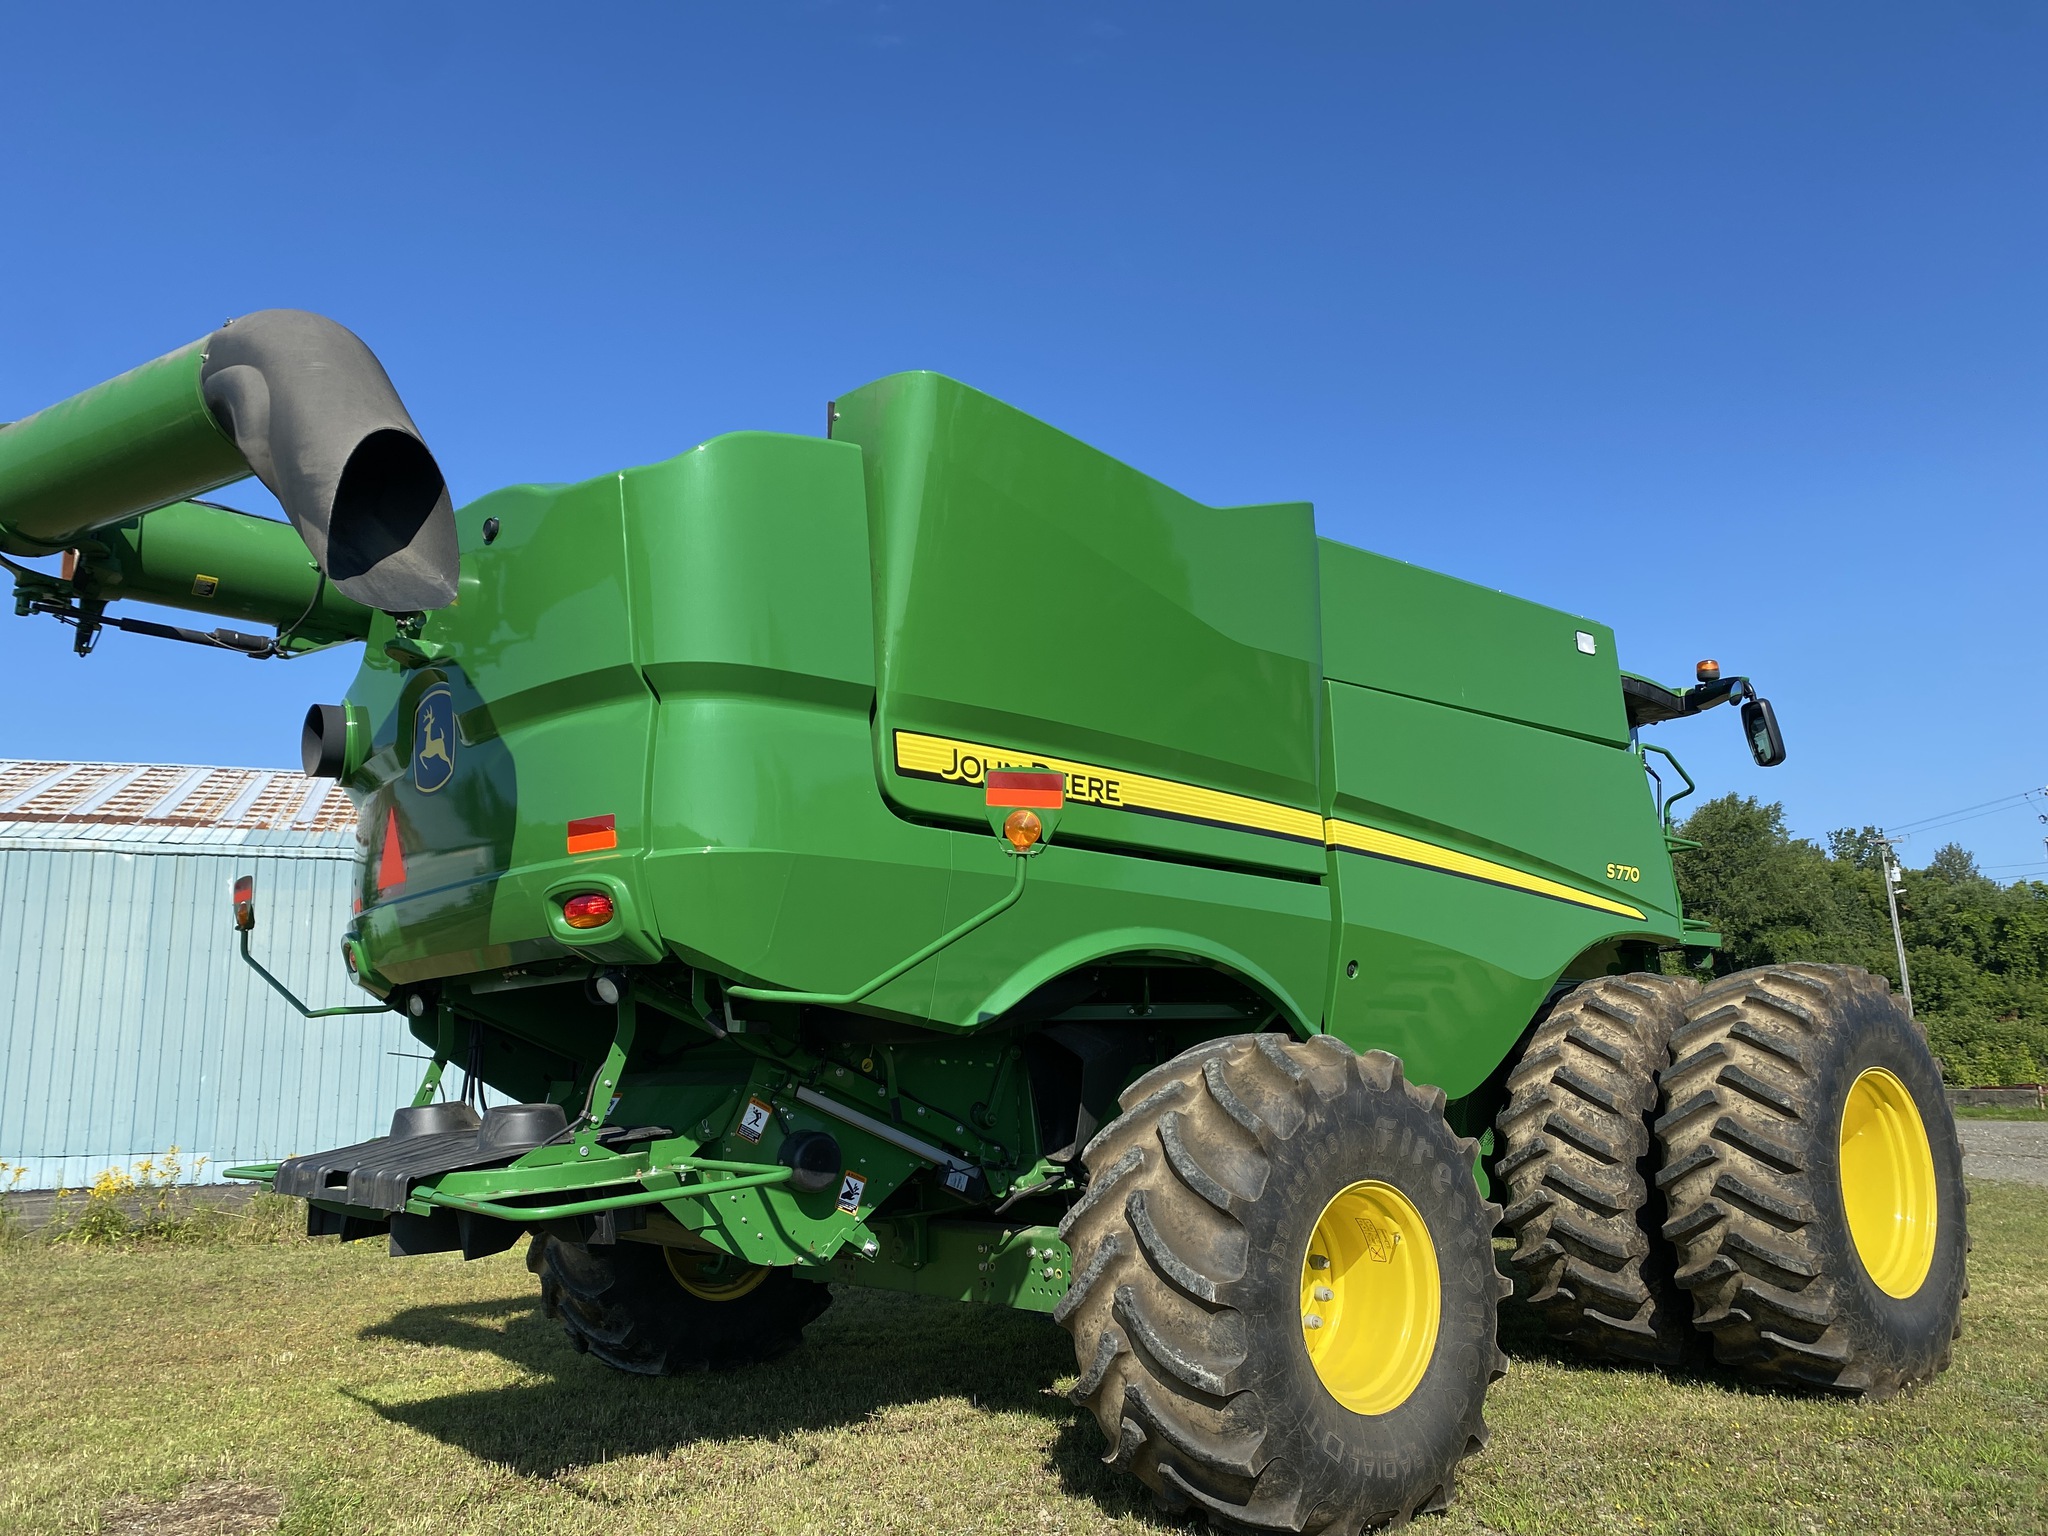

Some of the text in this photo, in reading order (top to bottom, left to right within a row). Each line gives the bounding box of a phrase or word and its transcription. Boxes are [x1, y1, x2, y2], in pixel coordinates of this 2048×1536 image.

[942, 748, 1120, 801] JO ERE
[1606, 862, 1640, 882] S770
